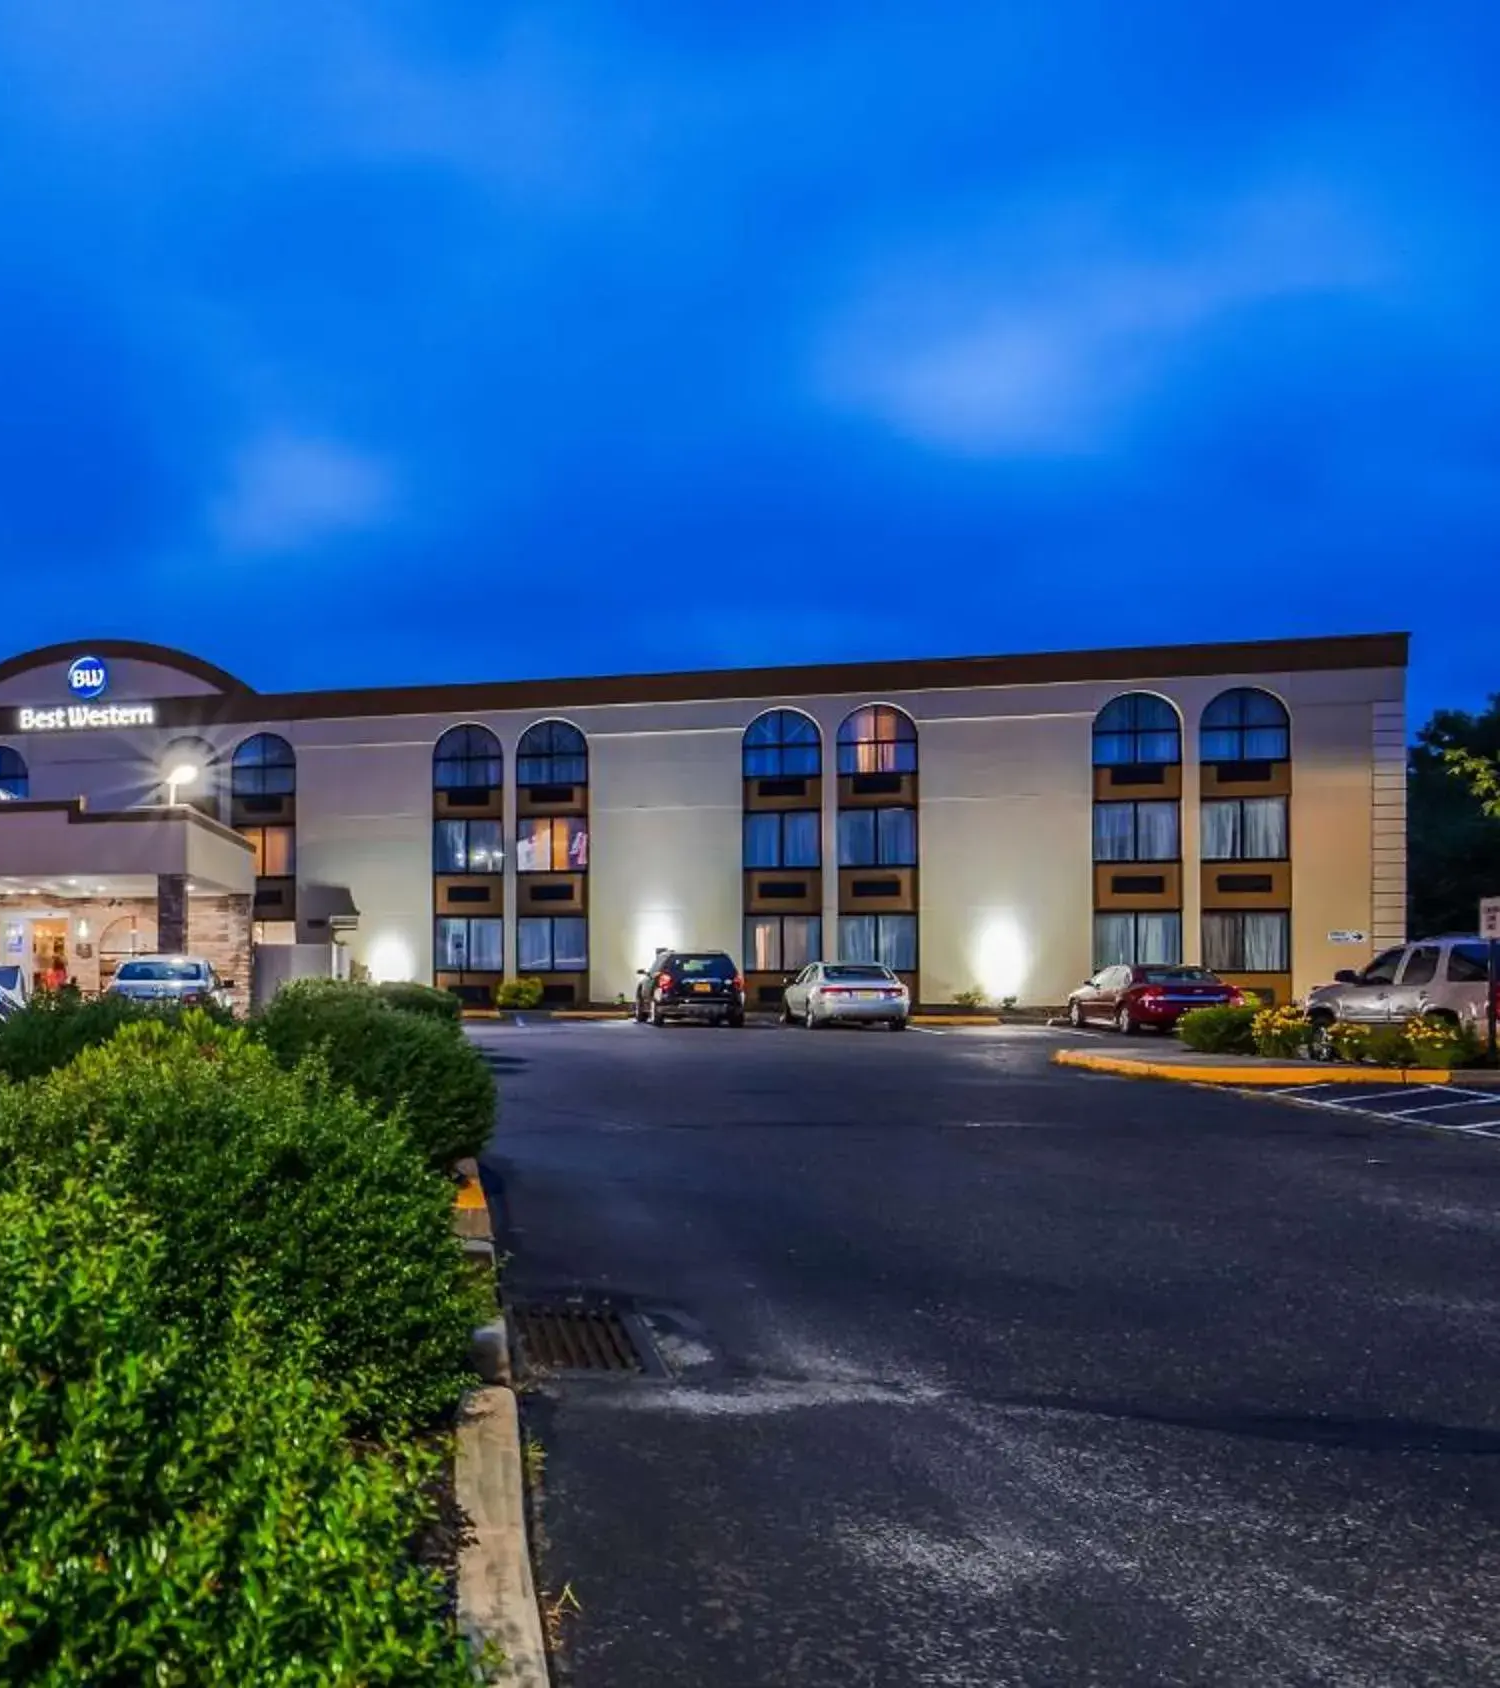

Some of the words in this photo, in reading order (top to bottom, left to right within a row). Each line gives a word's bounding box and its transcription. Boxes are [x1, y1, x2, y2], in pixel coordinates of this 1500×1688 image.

[72, 668, 106, 688] BW
[19, 708, 66, 729] Best
[67, 704, 155, 727] Western
